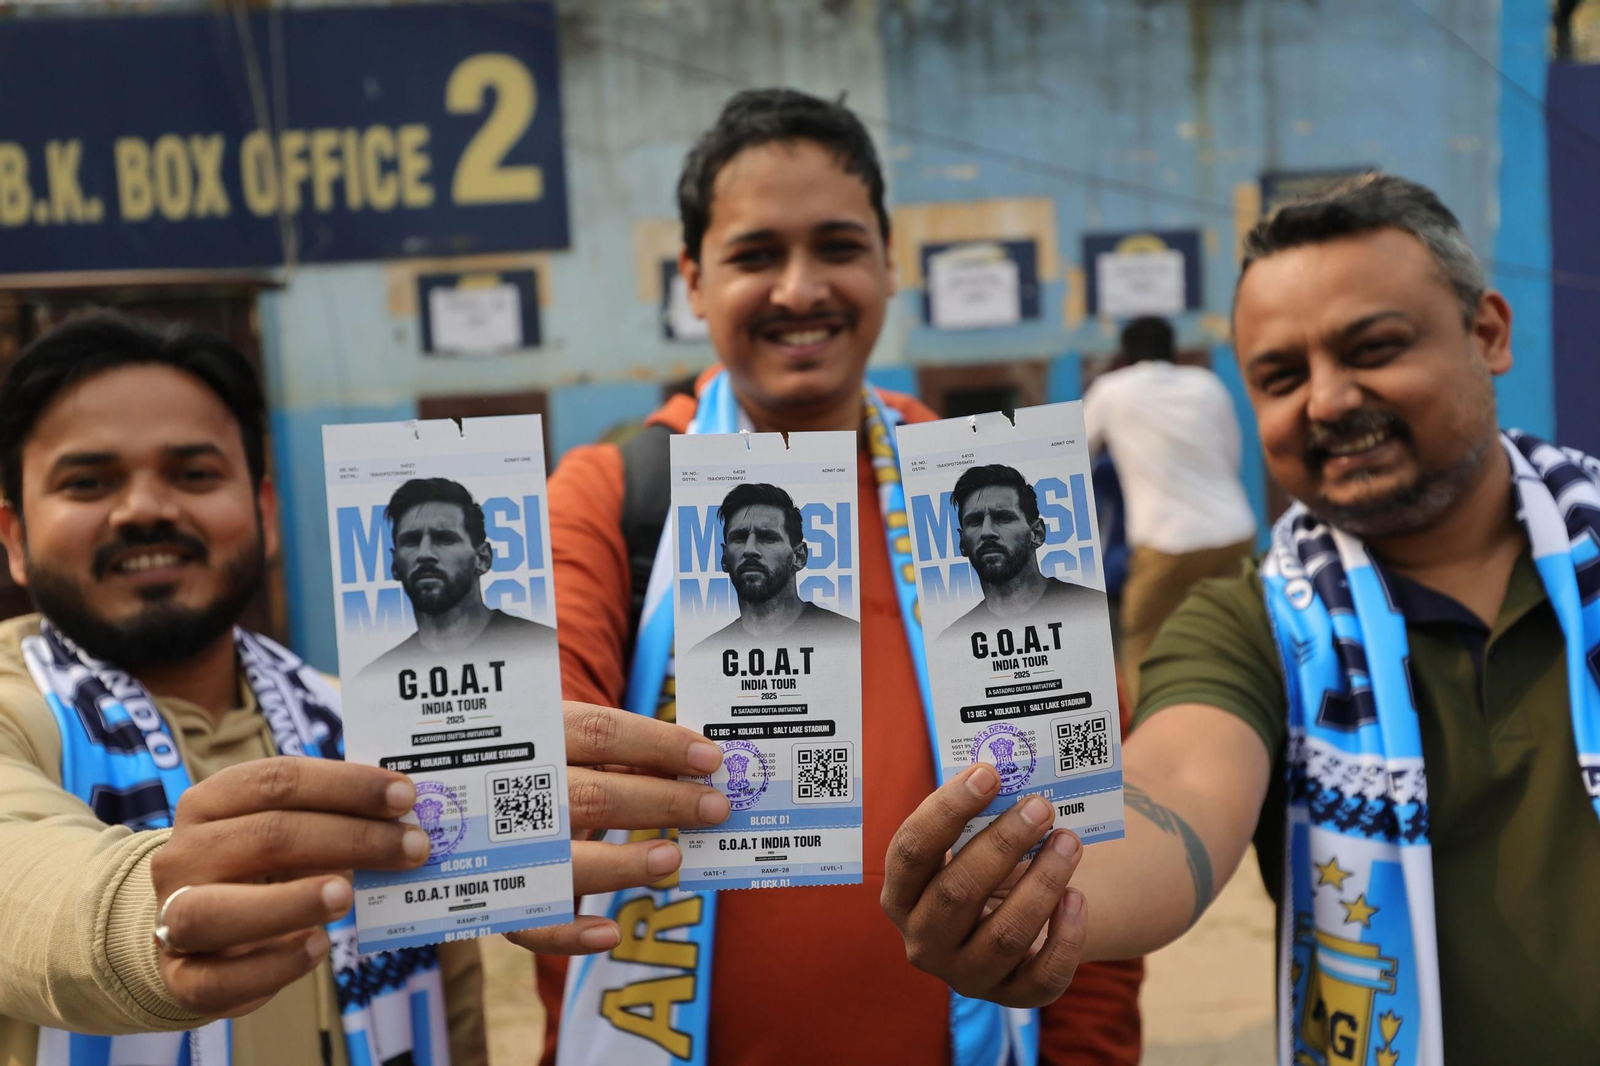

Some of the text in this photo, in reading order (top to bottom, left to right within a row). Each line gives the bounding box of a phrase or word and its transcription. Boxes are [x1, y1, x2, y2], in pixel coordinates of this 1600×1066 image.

[115, 134, 231, 221] BOX
[240, 124, 435, 217] OFFICE
[444, 52, 544, 205] 2
[910, 473, 1092, 562] MSI
[336, 495, 544, 584] MSI
[677, 502, 852, 573] MSI
[971, 622, 1062, 659] G.O.A.T
[722, 647, 814, 677] G.O.A.T
[992, 655, 1048, 672] INDIA TOUR
[398, 661, 505, 701] G.O.A.T
[1014, 671, 1030, 679] 2025
[741, 678, 796, 691] INDIA TOUR
[1016, 685, 1032, 693] DUTTA
[761, 692, 778, 700] 2025
[422, 698, 487, 716] INDIA TOUR
[966, 697, 1086, 719] 13 DEC KOLKATA SALT LAKE STADIUM
[446, 716, 465, 725] 2025
[710, 724, 830, 736] 13 DEC KOLKATA SALT LAKE STADIUM
[387, 747, 529, 771] 13 DEC KOLKATA SALT LAKE STADIUM
[1044, 788, 1054, 798] D1
[1058, 802, 1085, 817] TOUR
[750, 815, 790, 826] BLOCK D1
[1084, 825, 1106, 834] LEVEL-1
[718, 835, 822, 851] G.O.A.T INDIA TOUR
[441, 856, 488, 872] BLOCK D1
[404, 875, 526, 904] G.O.A.T INDIA TOUR
[456, 914, 490, 925] RAMP-28
[526, 906, 552, 915] LEVEL-1
